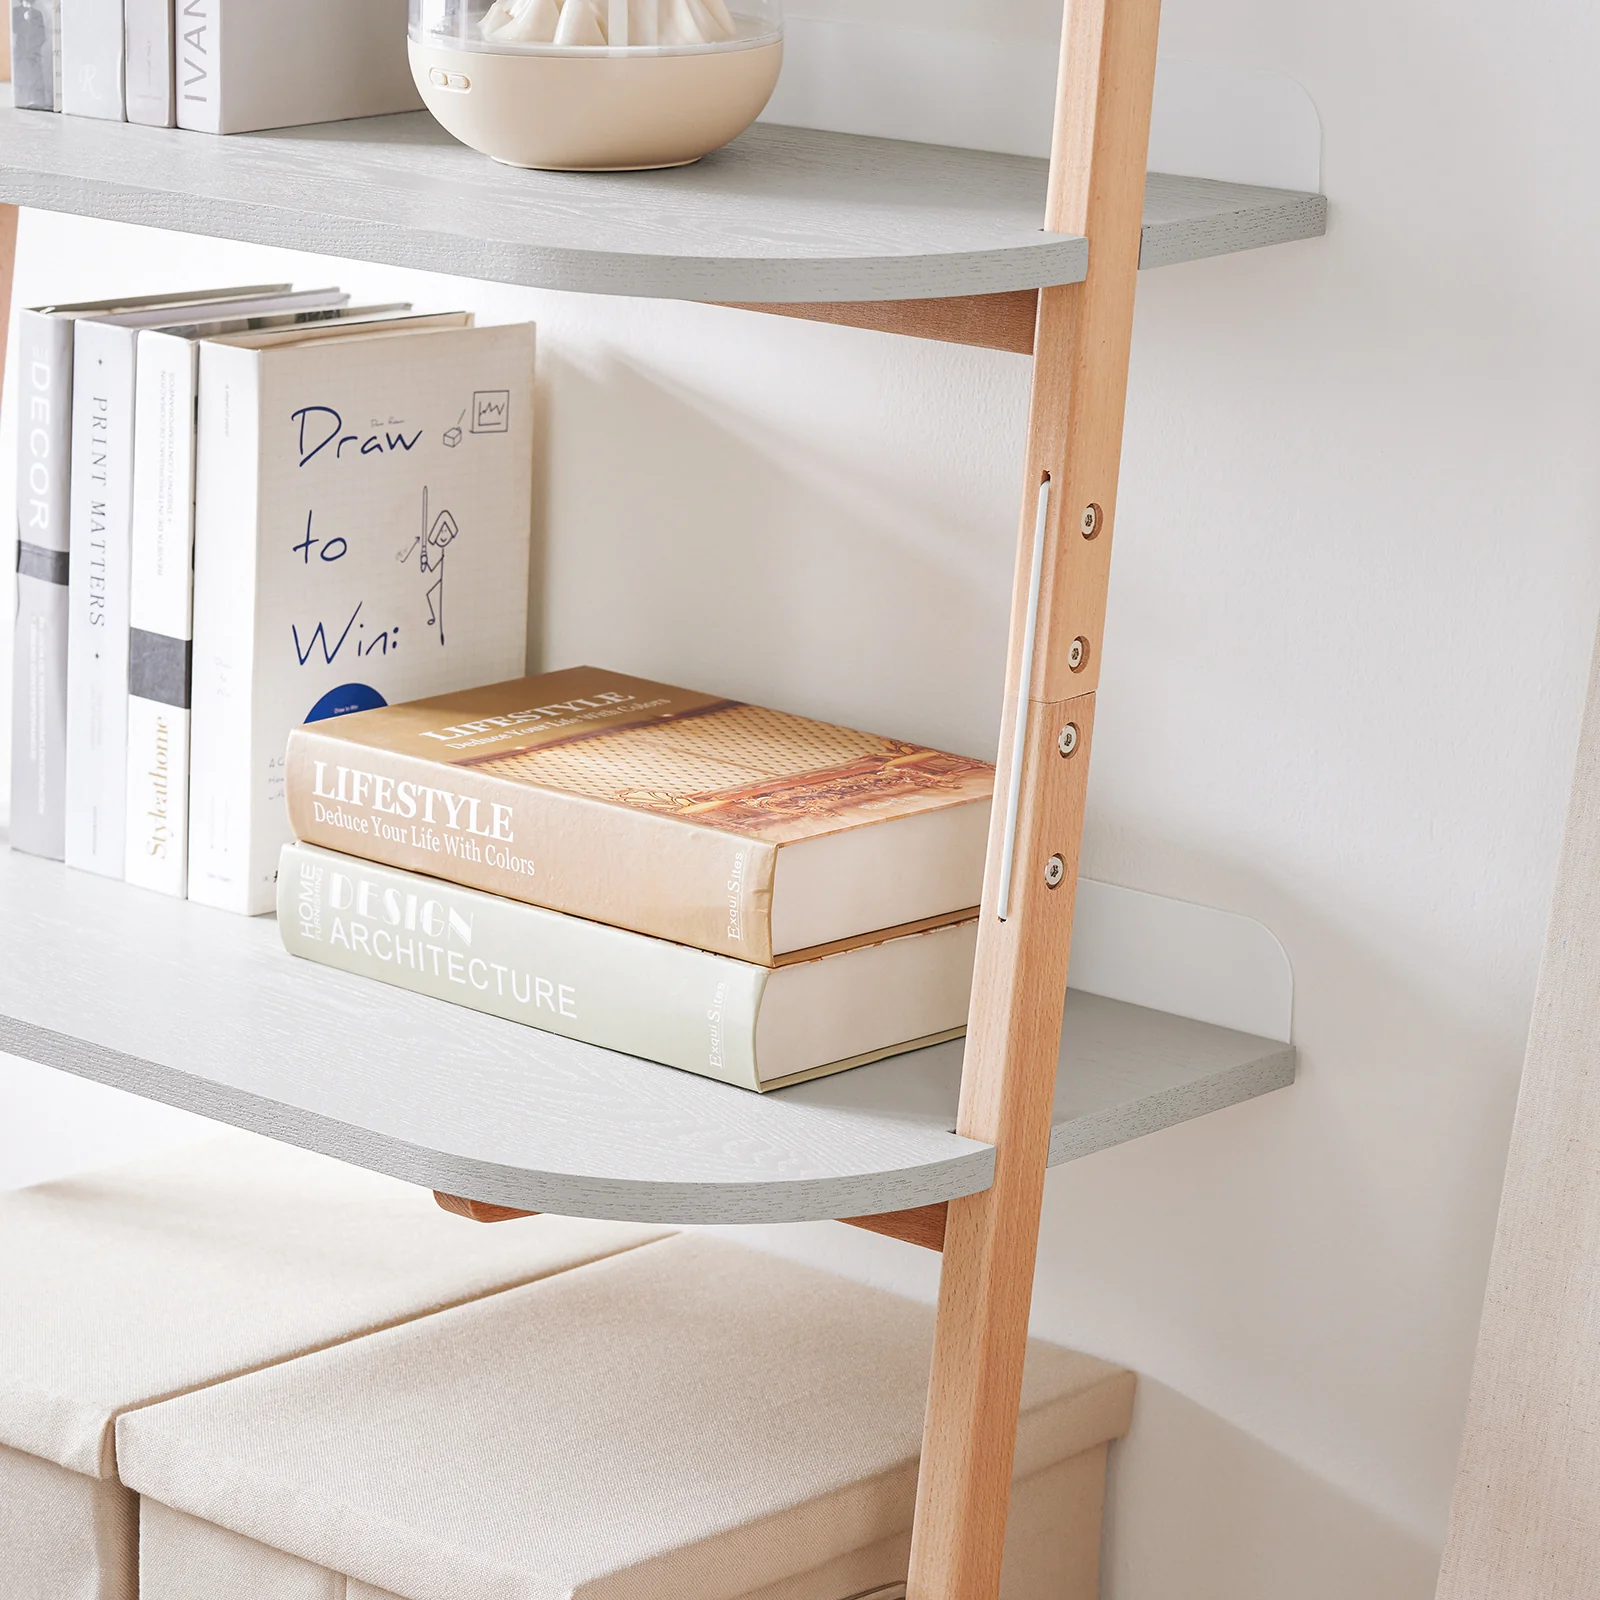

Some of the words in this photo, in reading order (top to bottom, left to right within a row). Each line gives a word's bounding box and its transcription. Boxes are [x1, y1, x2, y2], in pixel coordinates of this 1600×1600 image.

[29, 360, 51, 530] DECOR
[91, 395, 108, 487] PRINT
[291, 406, 422, 467] Draw
[89, 500, 107, 627] MATTERS
[292, 509, 347, 564] to
[419, 691, 635, 742] LIFESTYLE
[446, 733, 512, 750] Deduce
[506, 723, 550, 737] Your
[549, 716, 584, 729] Life
[581, 710, 618, 722] With
[615, 697, 672, 713] Colors
[147, 716, 174, 859] Styleathome
[312, 760, 514, 843] LIFESTYLE
[312, 801, 369, 834] Deduce
[371, 815, 408, 844] Your
[411, 825, 441, 853] Life
[443, 833, 482, 863] With
[485, 844, 535, 876] Colors
[299, 862, 316, 940] HOME
[329, 872, 475, 947] DESIGN
[330, 917, 578, 1020] ARCHITECTURE
